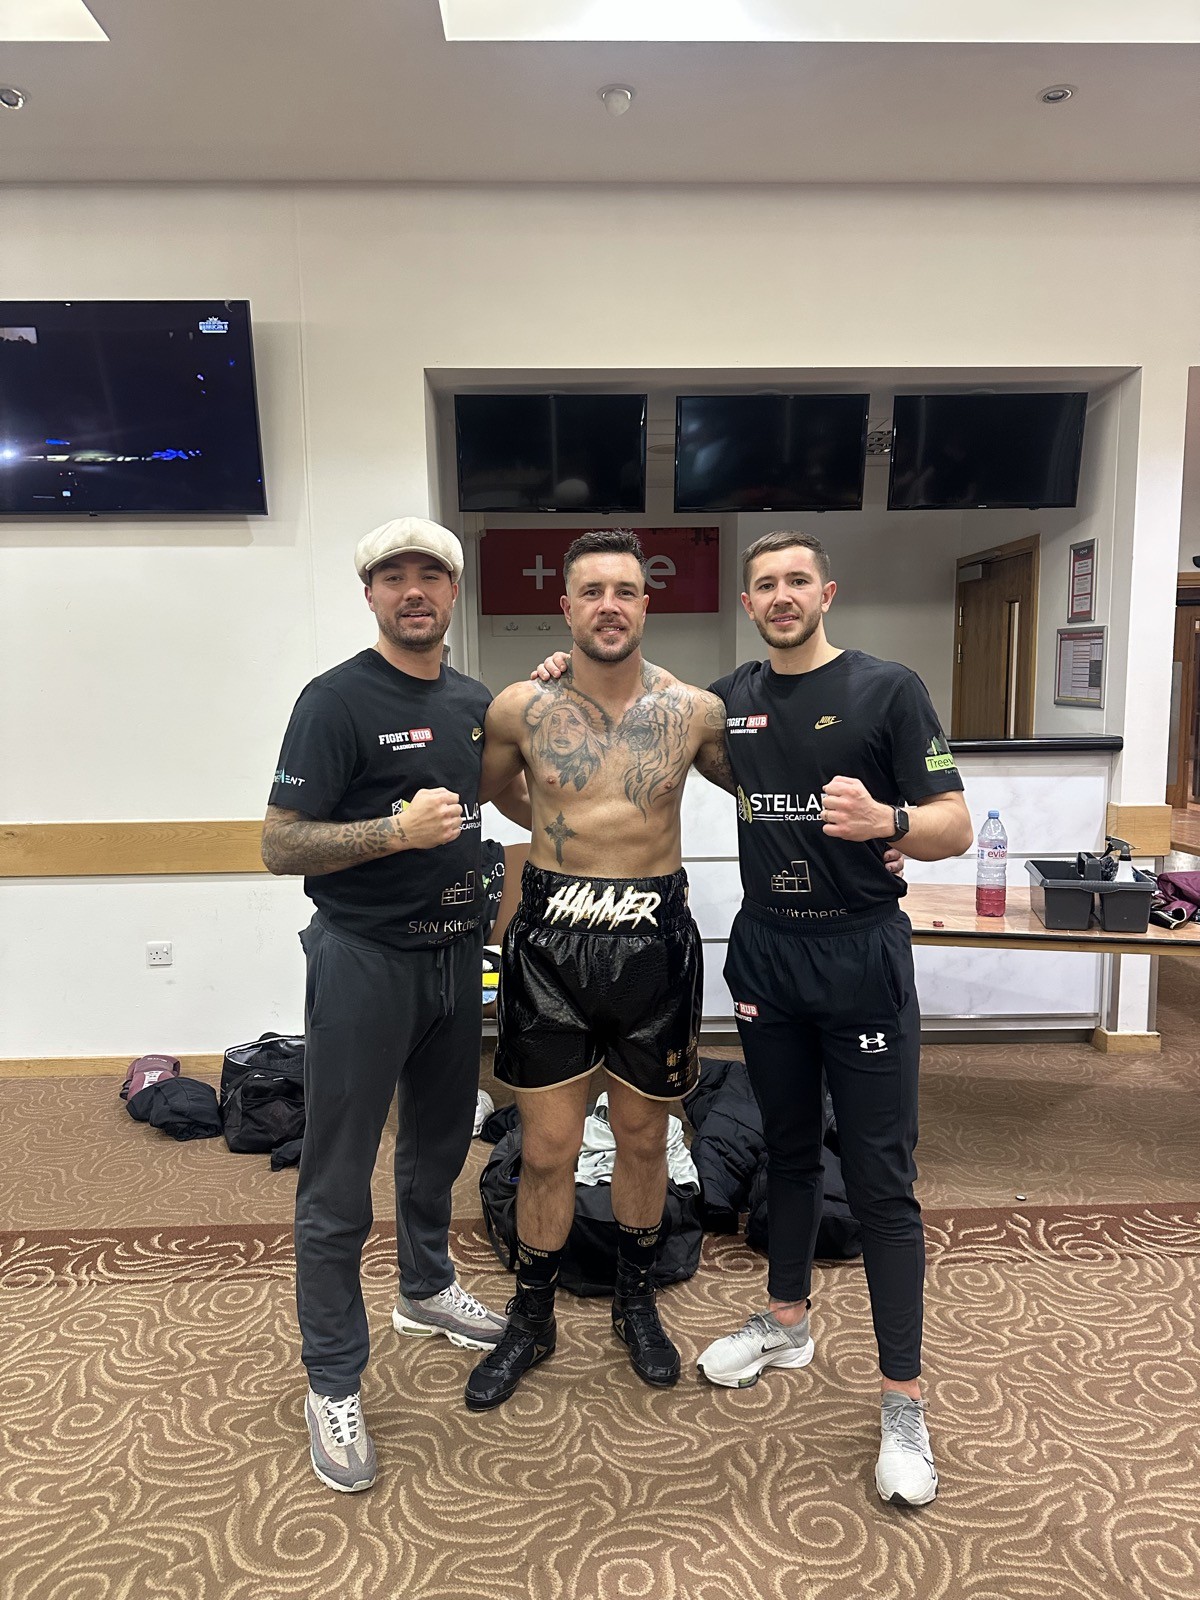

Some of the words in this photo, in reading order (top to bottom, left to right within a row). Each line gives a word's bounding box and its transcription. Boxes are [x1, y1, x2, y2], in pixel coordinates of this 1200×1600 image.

[748, 716, 767, 727] HUB
[378, 731, 409, 745] FIGHT
[410, 730, 431, 741] HUB
[542, 881, 661, 931] HAMMER
[407, 920, 440, 934] SKN
[740, 1003, 757, 1015] HUB
